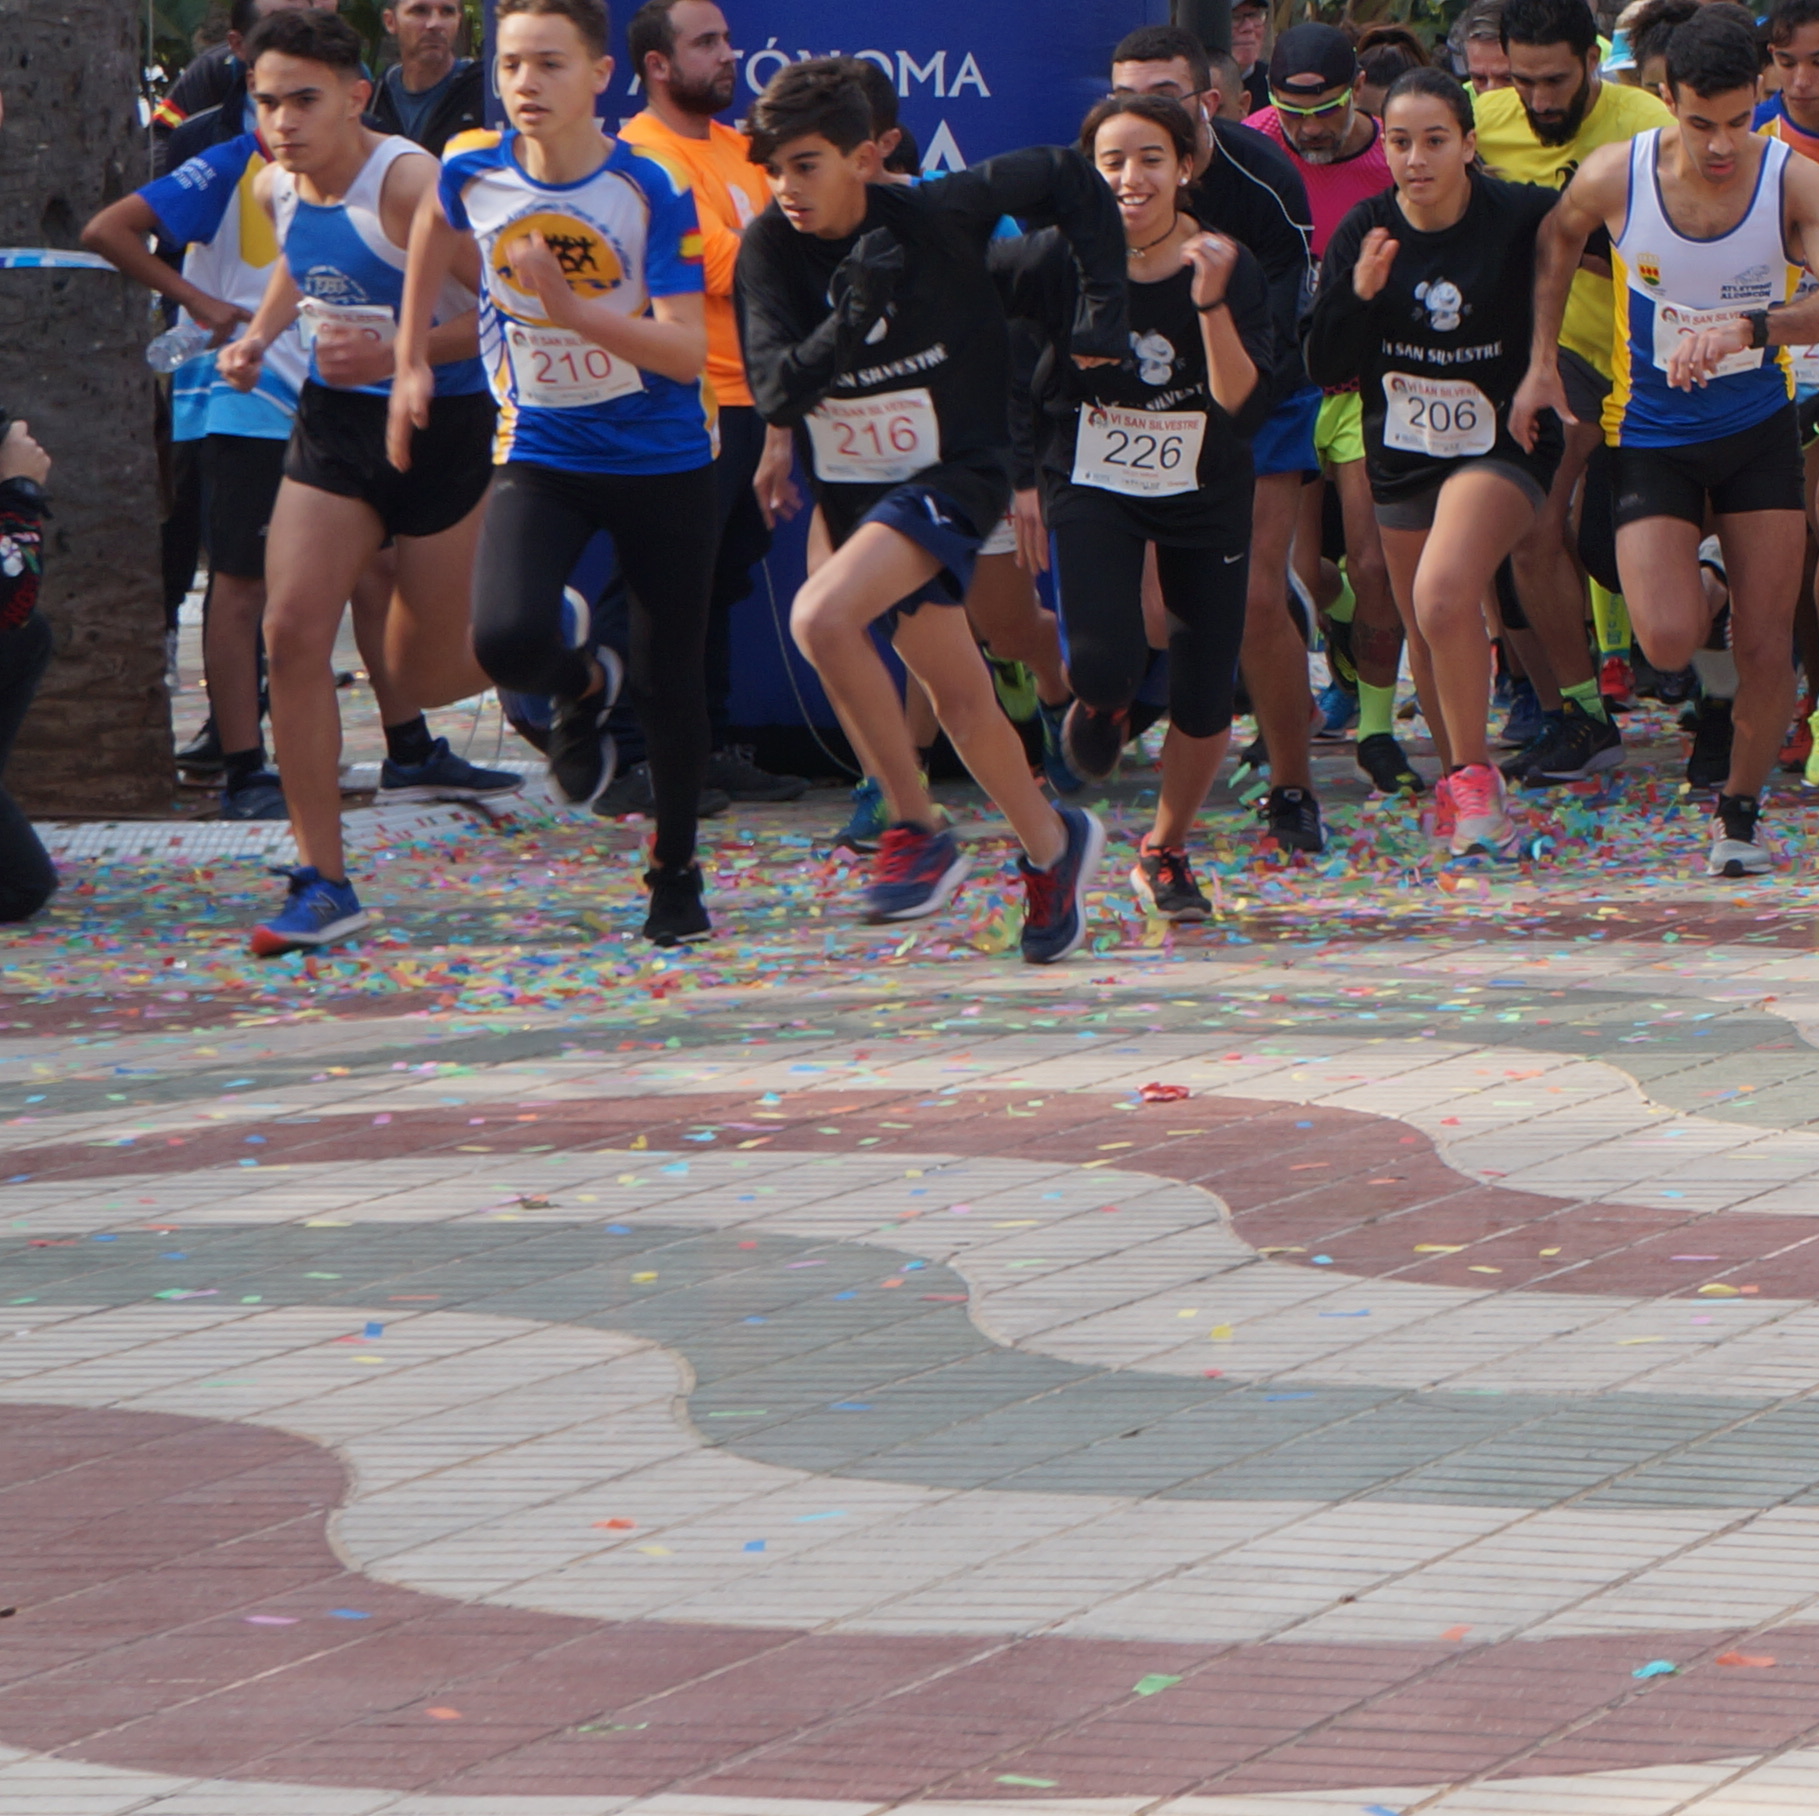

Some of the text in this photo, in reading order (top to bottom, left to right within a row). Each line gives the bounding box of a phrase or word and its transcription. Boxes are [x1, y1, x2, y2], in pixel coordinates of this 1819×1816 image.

[531, 349, 612, 383] 210
[858, 341, 949, 387] SILVESTRE
[1395, 342, 1424, 361] SAN
[1428, 340, 1503, 367] SILVESTRE
[1146, 383, 1203, 411] SILVEST
[1408, 396, 1477, 432] 206
[832, 415, 919, 456] 216
[1111, 413, 1199, 432] VI SAN SILVESTRE
[1103, 430, 1183, 470] 226
